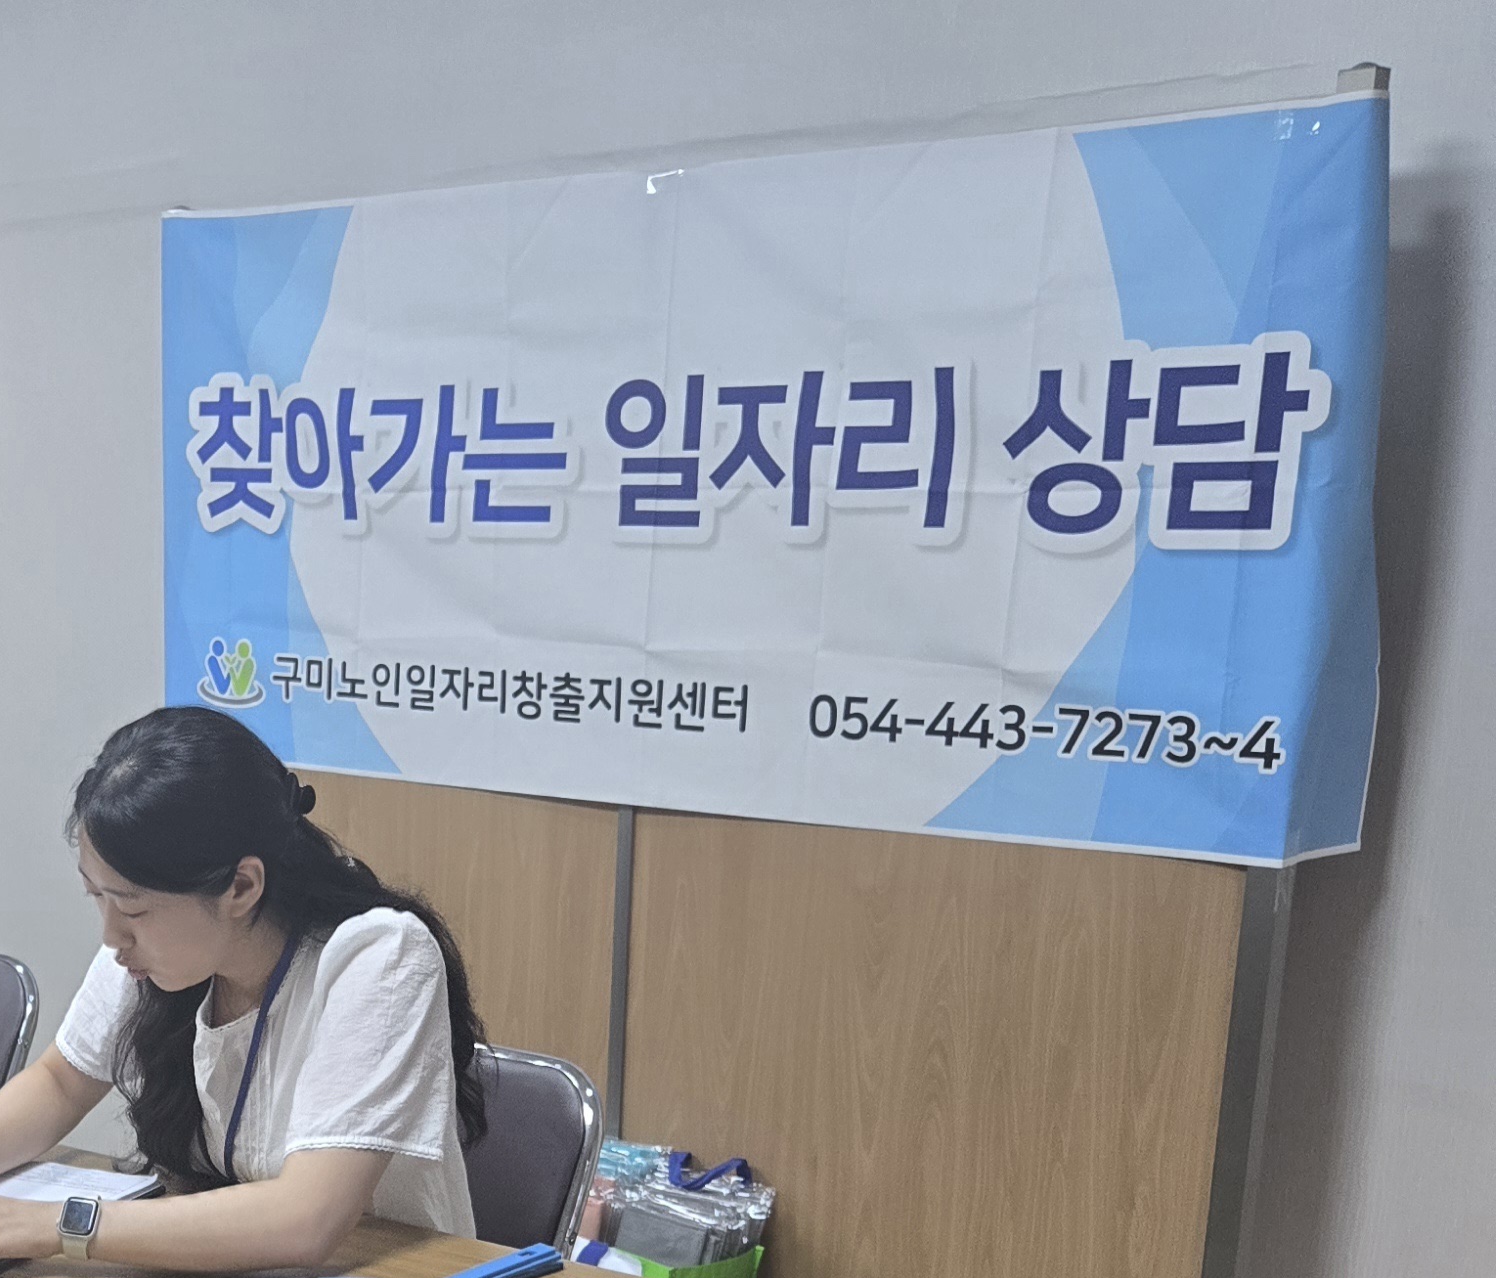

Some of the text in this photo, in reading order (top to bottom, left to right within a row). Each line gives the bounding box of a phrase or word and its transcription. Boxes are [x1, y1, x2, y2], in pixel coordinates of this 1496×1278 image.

[196, 350, 1311, 536] 찾아가는 일자리 상담
[269, 654, 751, 733] 구미노인일자리창출지원센터
[807, 693, 1283, 771] 054-443-7273~4
